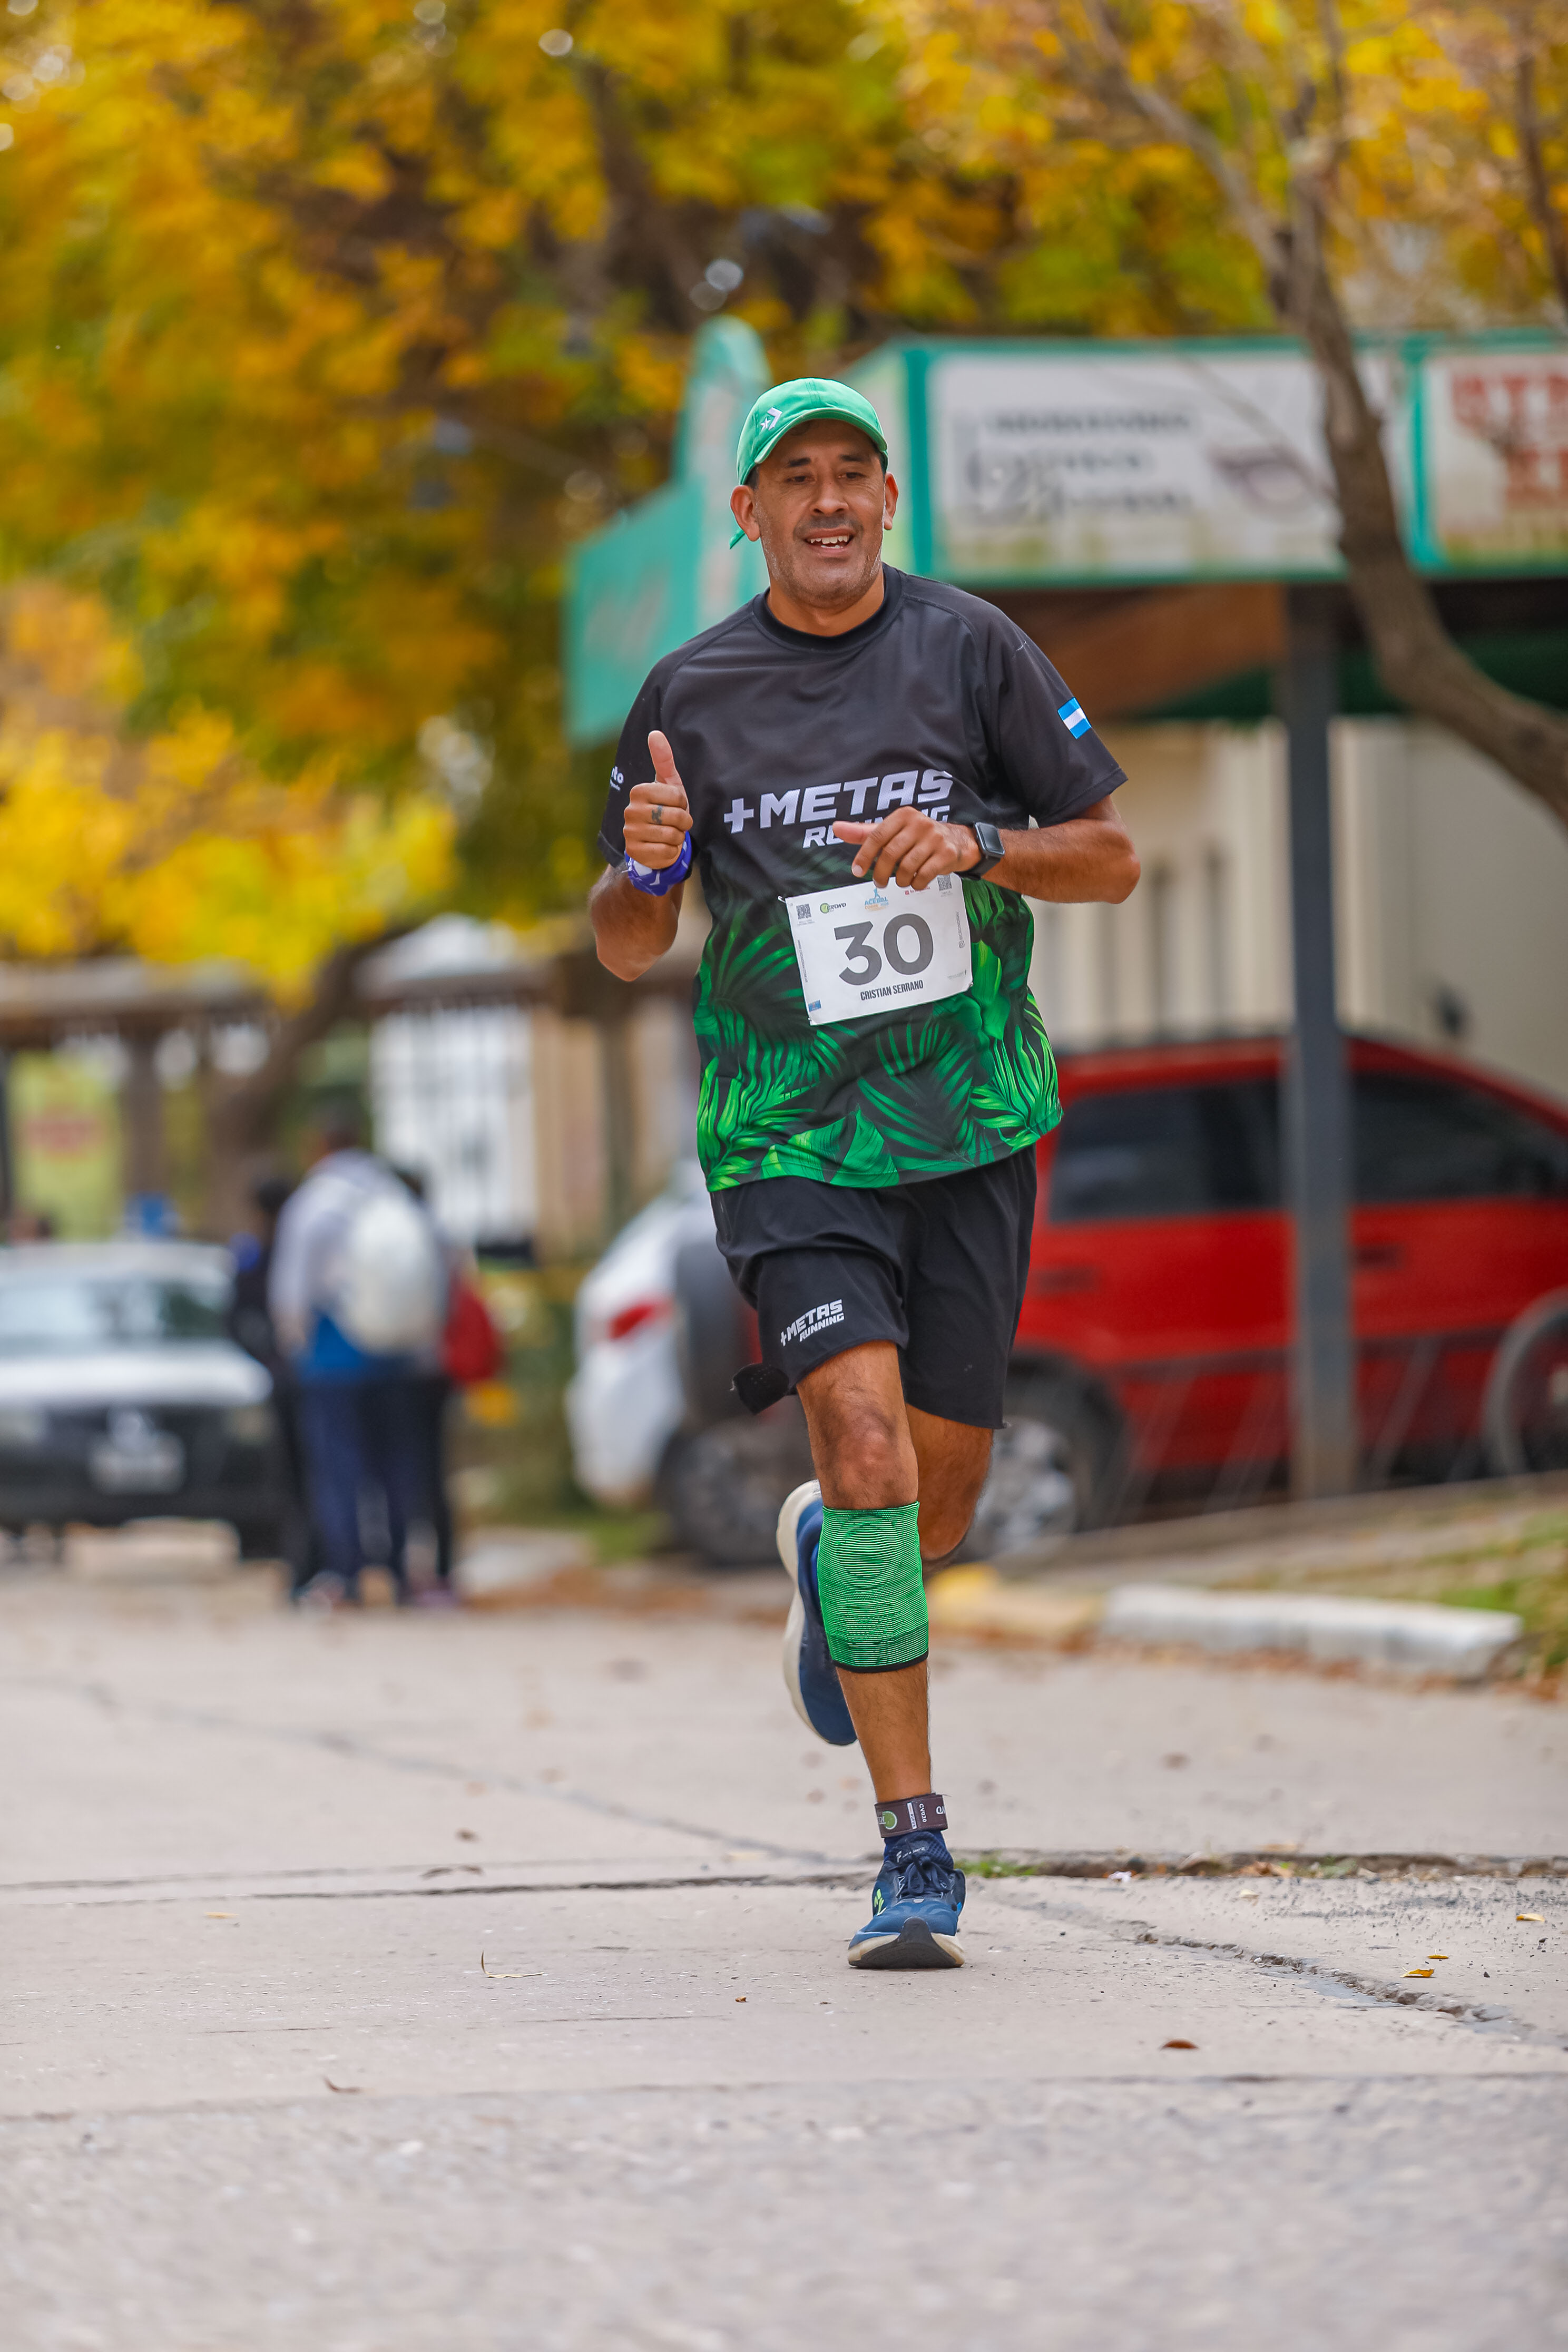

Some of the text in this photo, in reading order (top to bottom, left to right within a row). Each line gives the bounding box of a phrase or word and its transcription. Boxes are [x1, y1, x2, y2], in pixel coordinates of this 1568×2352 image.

[834, 913, 934, 985] 30
[860, 979, 924, 1001] CRISTIAN SERRANO
[799, 1312, 845, 1342] RUNNING
